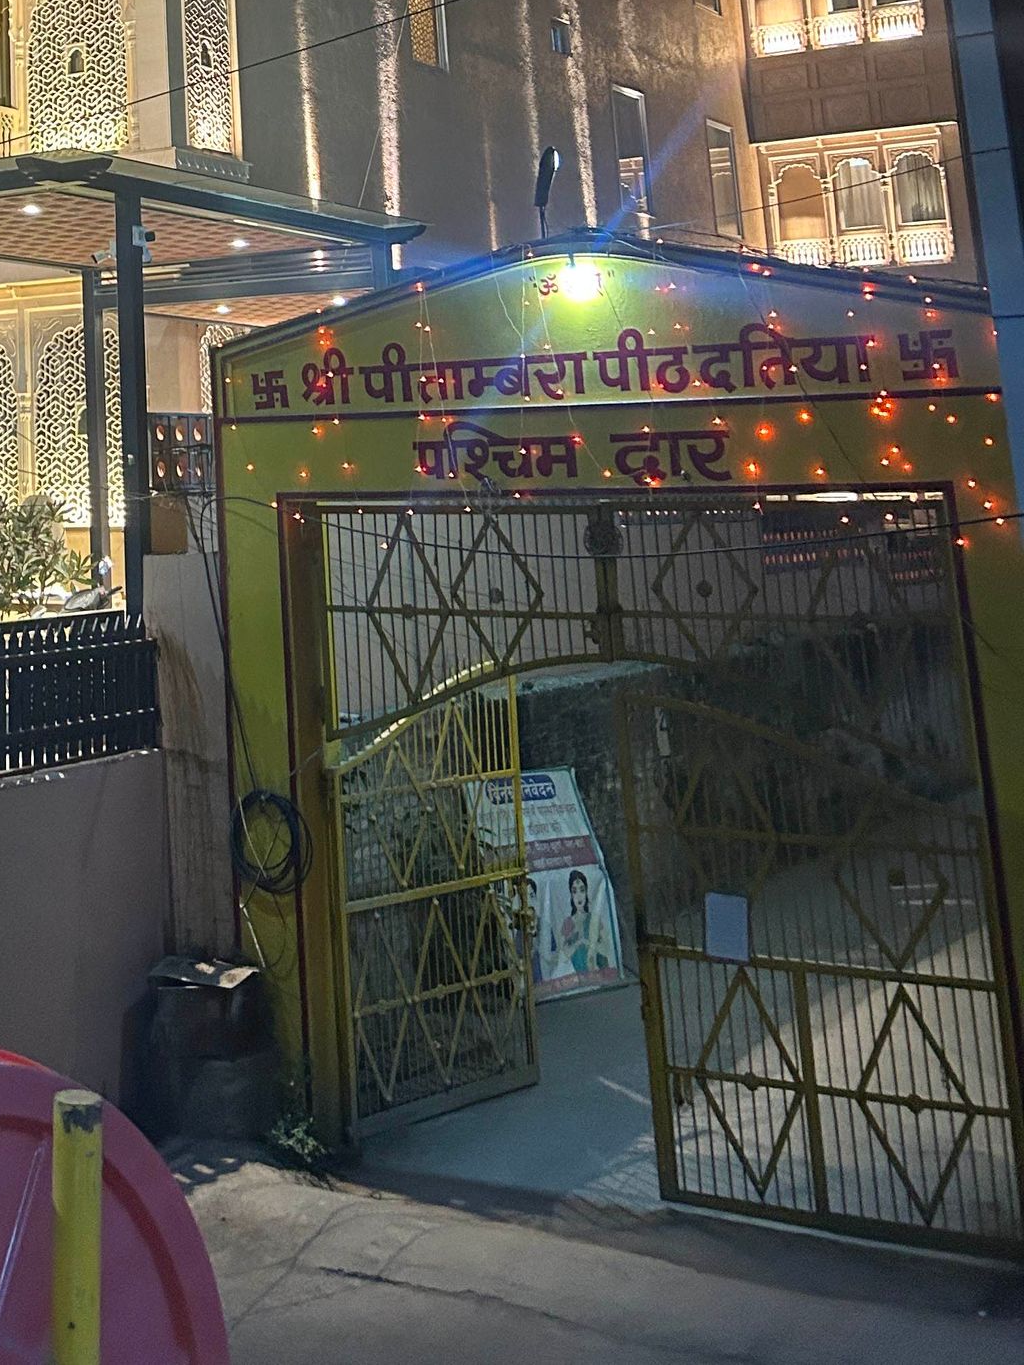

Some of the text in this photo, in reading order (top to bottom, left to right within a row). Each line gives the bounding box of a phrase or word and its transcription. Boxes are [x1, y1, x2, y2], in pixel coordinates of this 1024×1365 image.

[301, 322, 871, 405] श्री पीताम्बरा पीठ दतिया
[412, 421, 732, 485] पश्चिम द्वार
